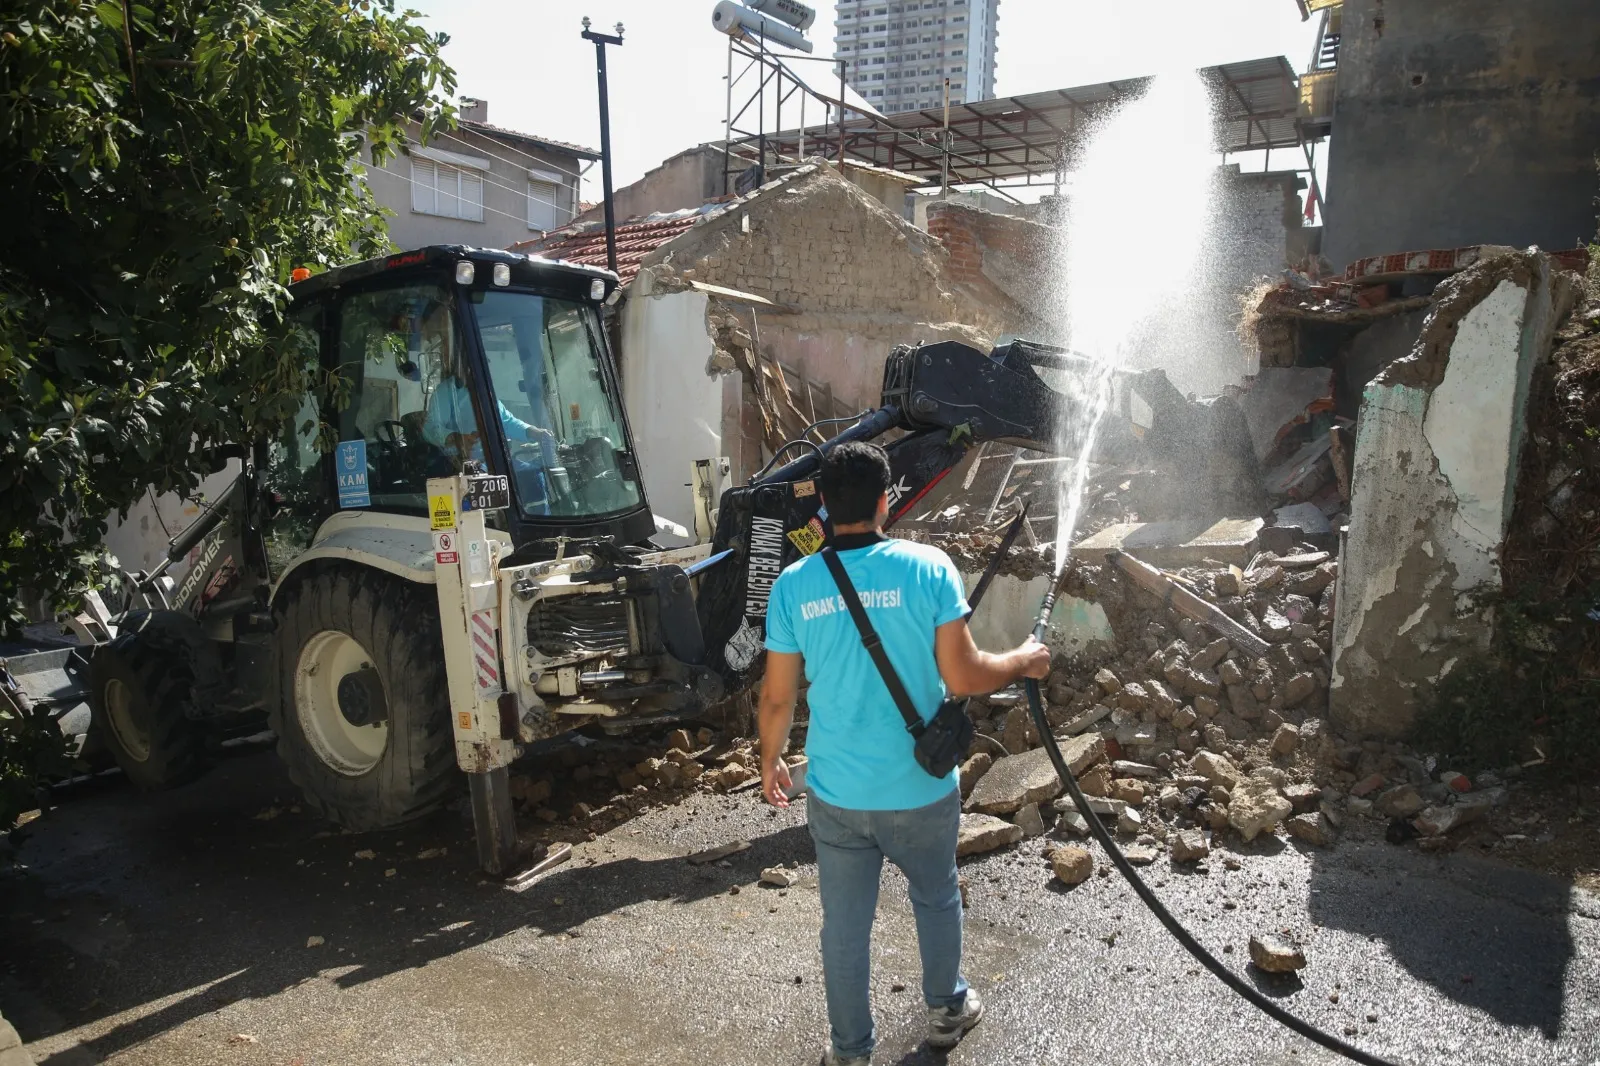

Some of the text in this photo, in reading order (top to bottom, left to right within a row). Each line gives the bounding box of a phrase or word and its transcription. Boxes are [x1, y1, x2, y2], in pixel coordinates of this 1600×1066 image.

[340, 473, 365, 486] KAM
[479, 495, 491, 508] 01
[750, 515, 784, 556] KONAK
[800, 587, 901, 621] KONAK BEDİYESİ
